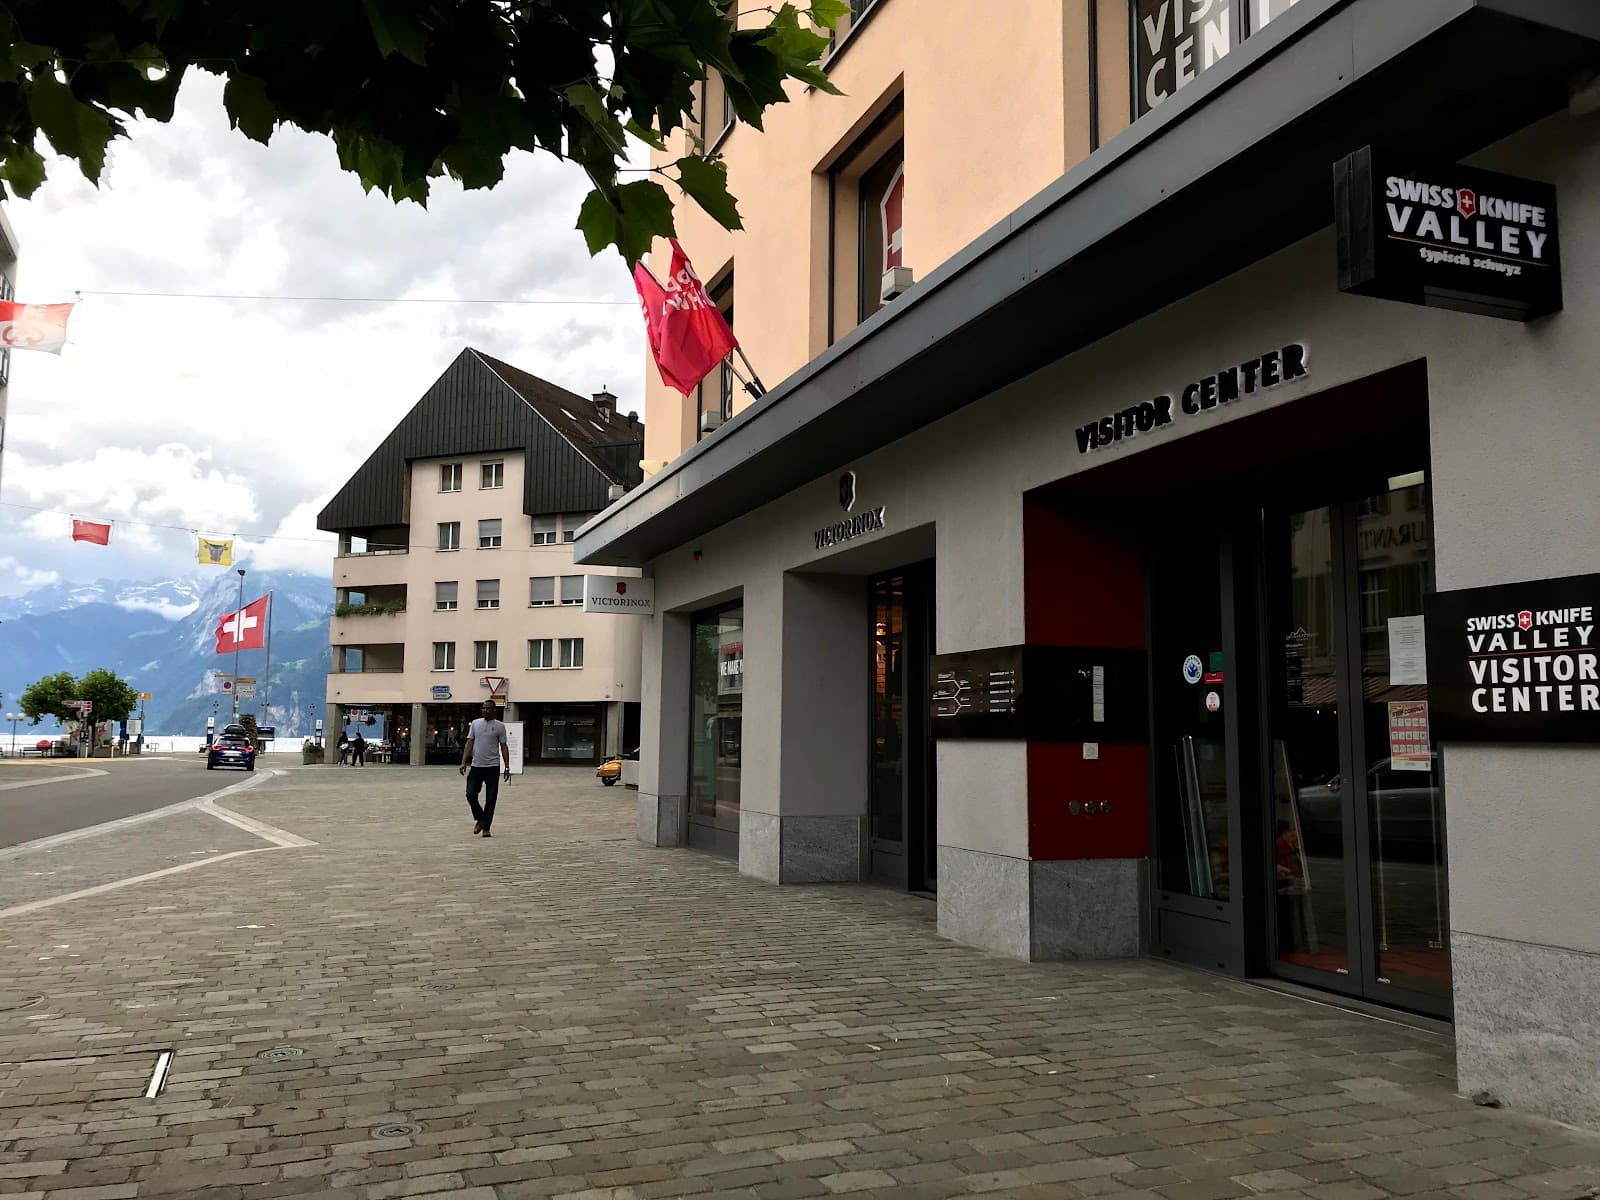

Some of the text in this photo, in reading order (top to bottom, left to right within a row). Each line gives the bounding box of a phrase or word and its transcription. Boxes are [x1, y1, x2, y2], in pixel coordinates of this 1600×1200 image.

[1386, 176, 1546, 227] SWISS KNIFE
[1386, 203, 1548, 259] VALLEY
[1419, 247, 1522, 276] typisch schwyz
[1075, 344, 1308, 454] VISITOR CENTER
[815, 506, 885, 549] VICTORINOX
[592, 597, 650, 608] VICTORINOX
[1467, 607, 1592, 631] SWISS KNIFE
[1467, 625, 1594, 652] VALLEY
[1469, 654, 1599, 684] VISITOR
[1472, 684, 1600, 713] CENTER
